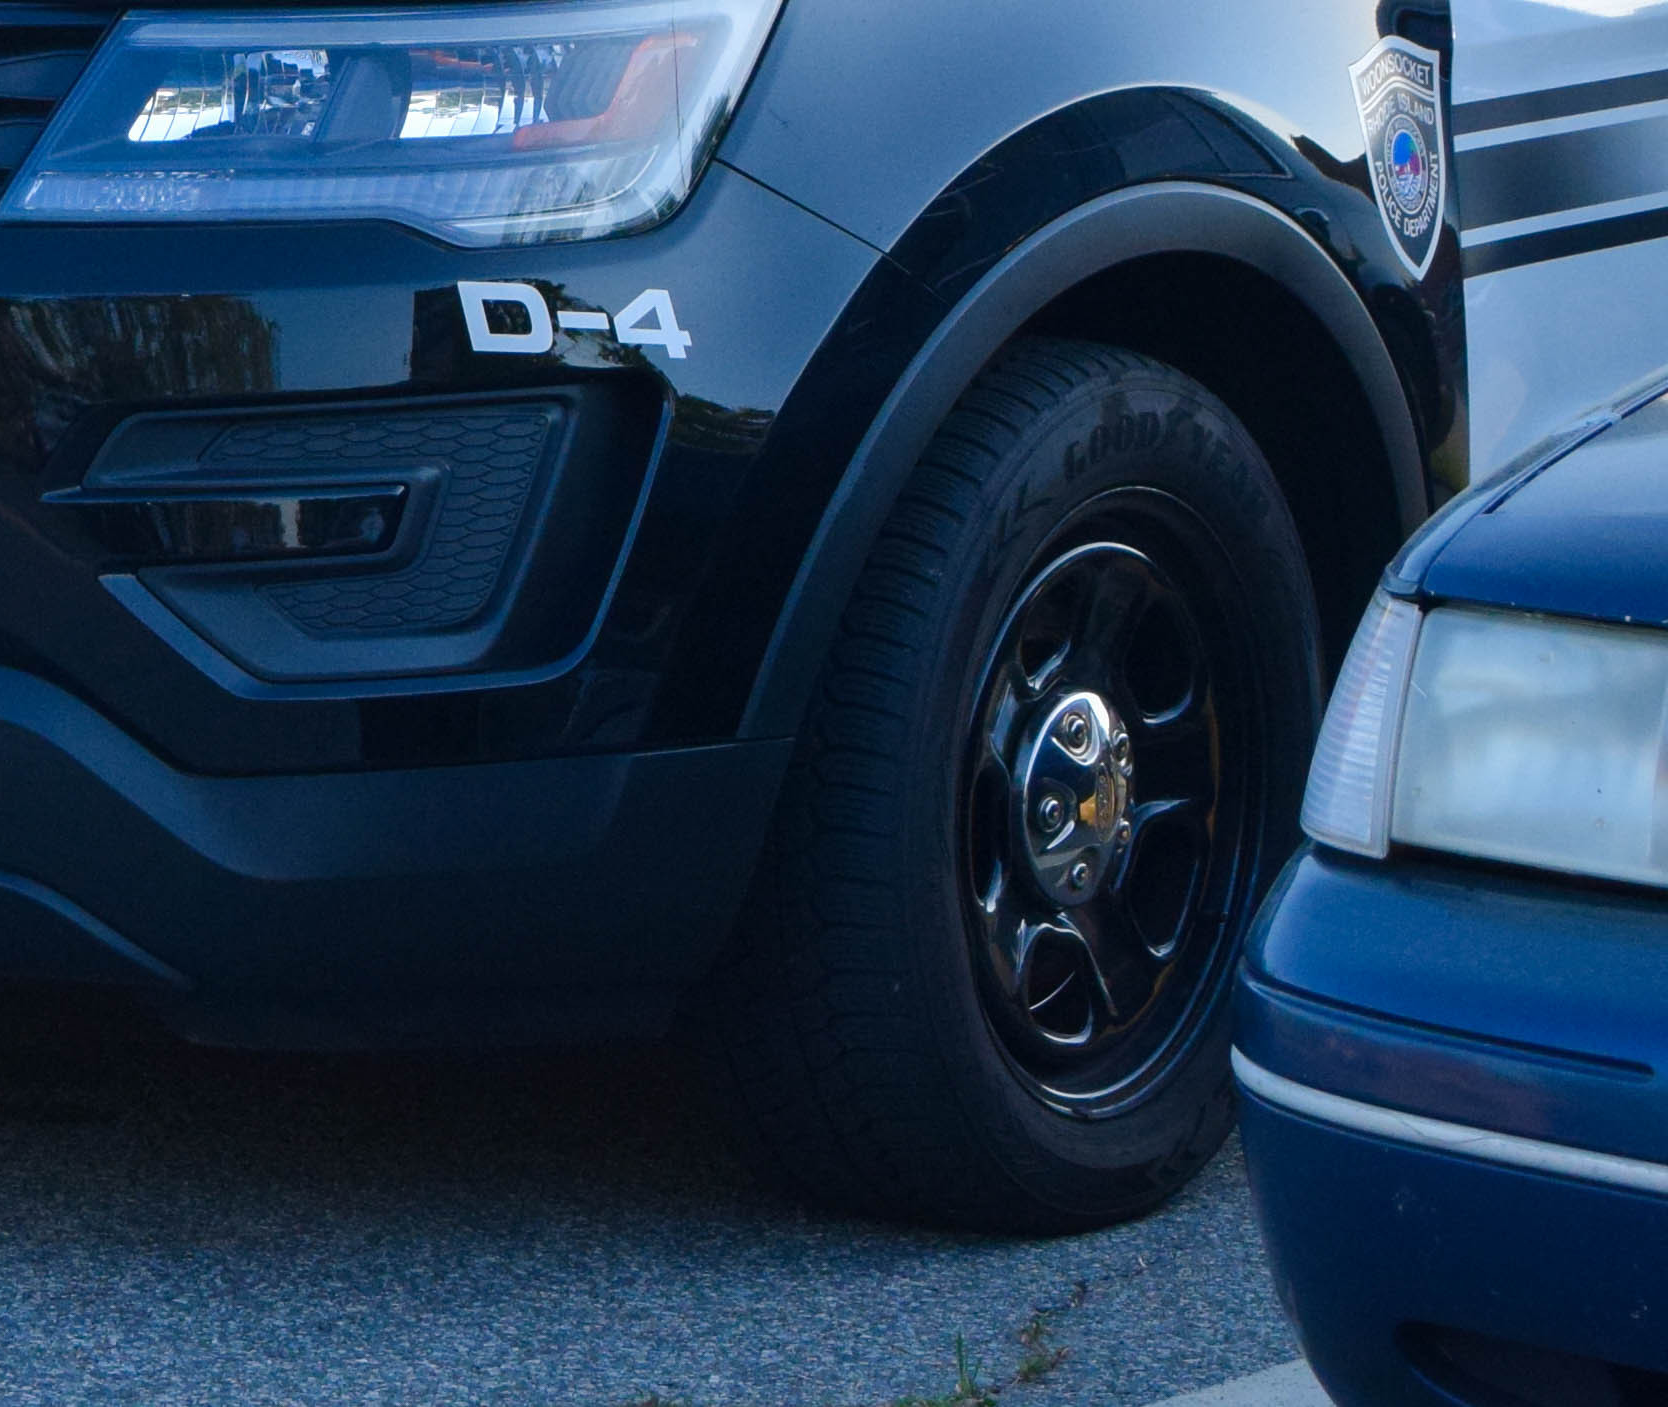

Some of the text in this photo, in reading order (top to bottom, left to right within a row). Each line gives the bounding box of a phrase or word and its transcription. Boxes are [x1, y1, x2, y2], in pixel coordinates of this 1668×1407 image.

[1360, 53, 1431, 97] WOONSOCKET
[1366, 91, 1435, 137] RHODE ISLAND
[1374, 160, 1403, 229] POLICE
[1403, 151, 1439, 238] DEPARTMENT
[456, 280, 693, 359] D-4
